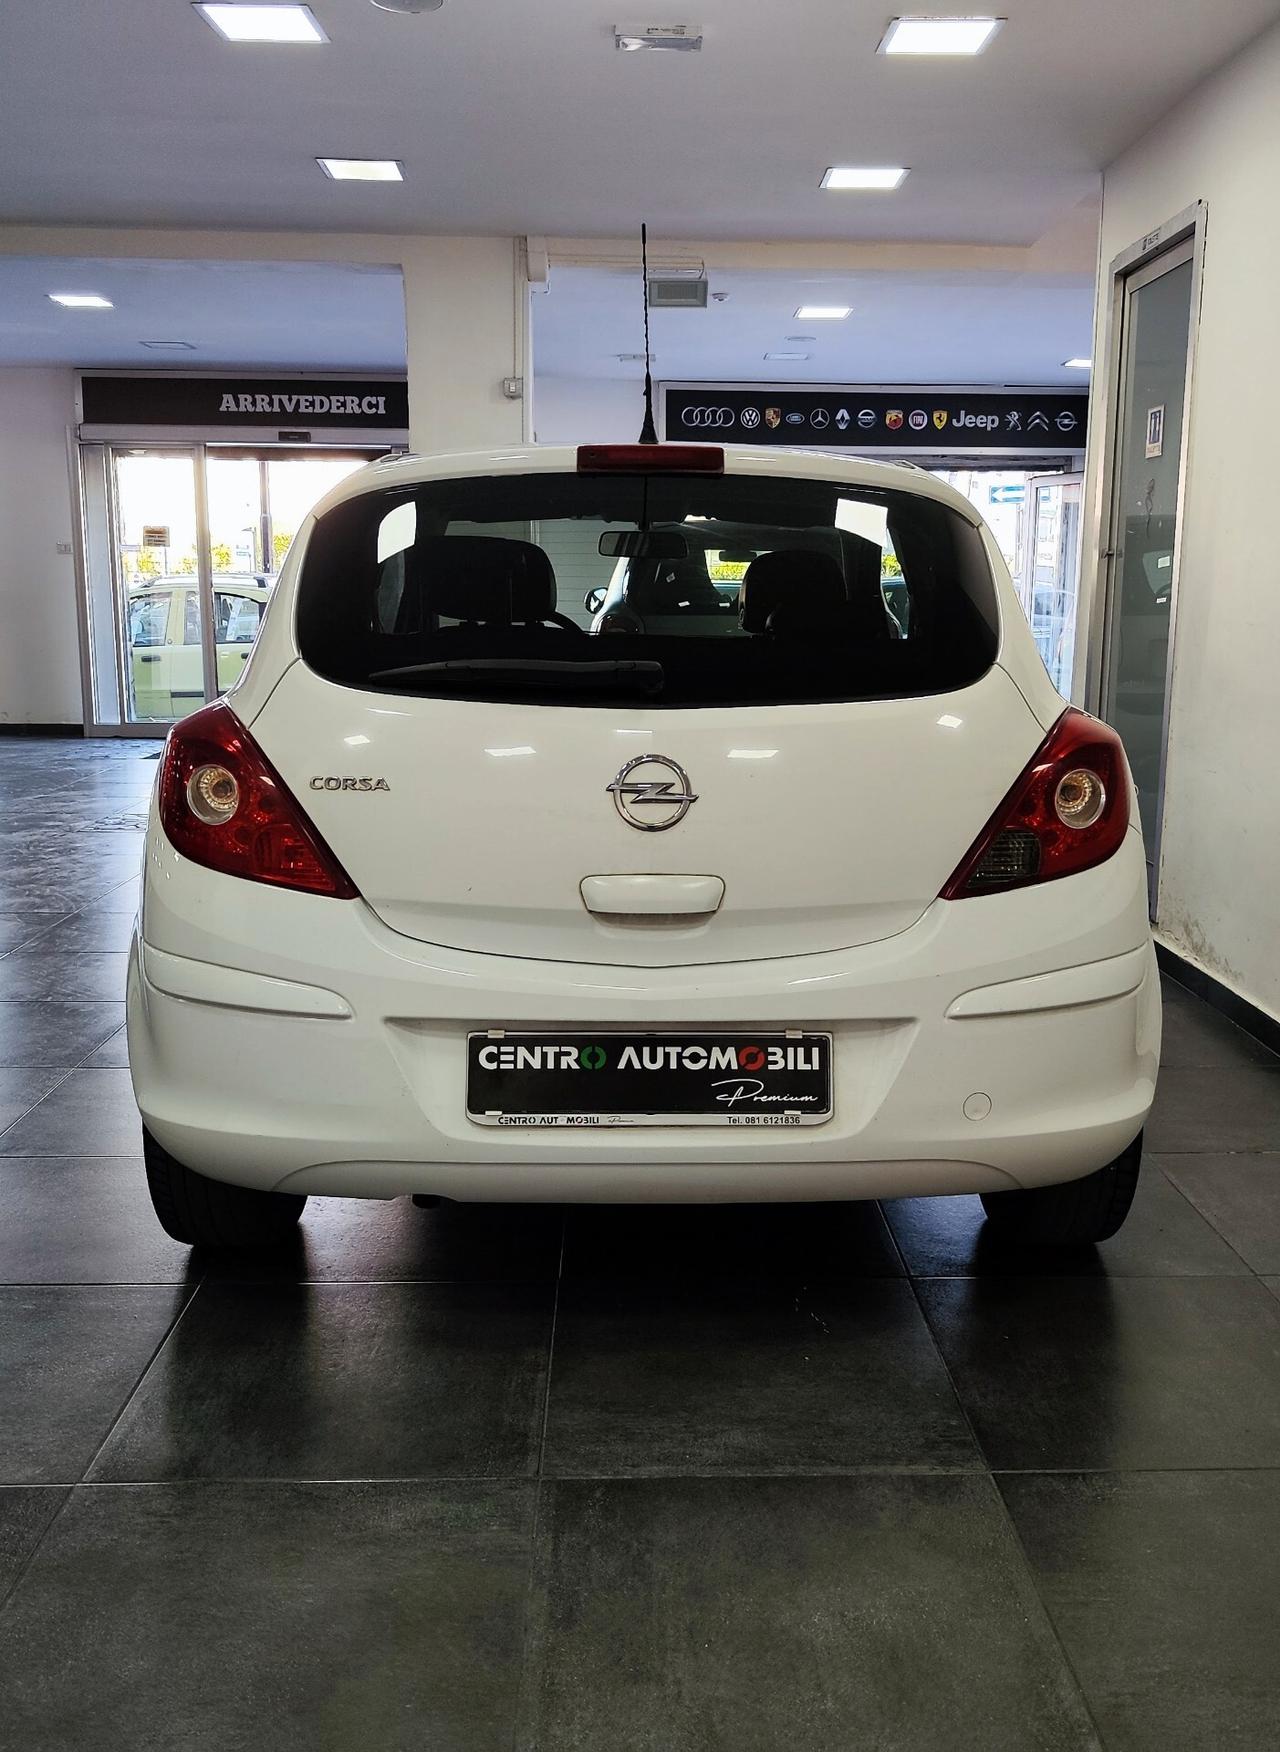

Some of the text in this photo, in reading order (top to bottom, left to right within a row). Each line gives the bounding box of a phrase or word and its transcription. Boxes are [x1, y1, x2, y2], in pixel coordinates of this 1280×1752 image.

[219, 393, 386, 414] ARRIVEDERCI
[952, 410, 999, 431] Jeep
[309, 776, 391, 791] CORSA
[478, 1045, 820, 1071] CENTRO AUTOMOBILI
[711, 1078, 819, 1107] Premium
[498, 1116, 536, 1125] CENTRO
[727, 1116, 801, 1125] Tel. 081 6121836
